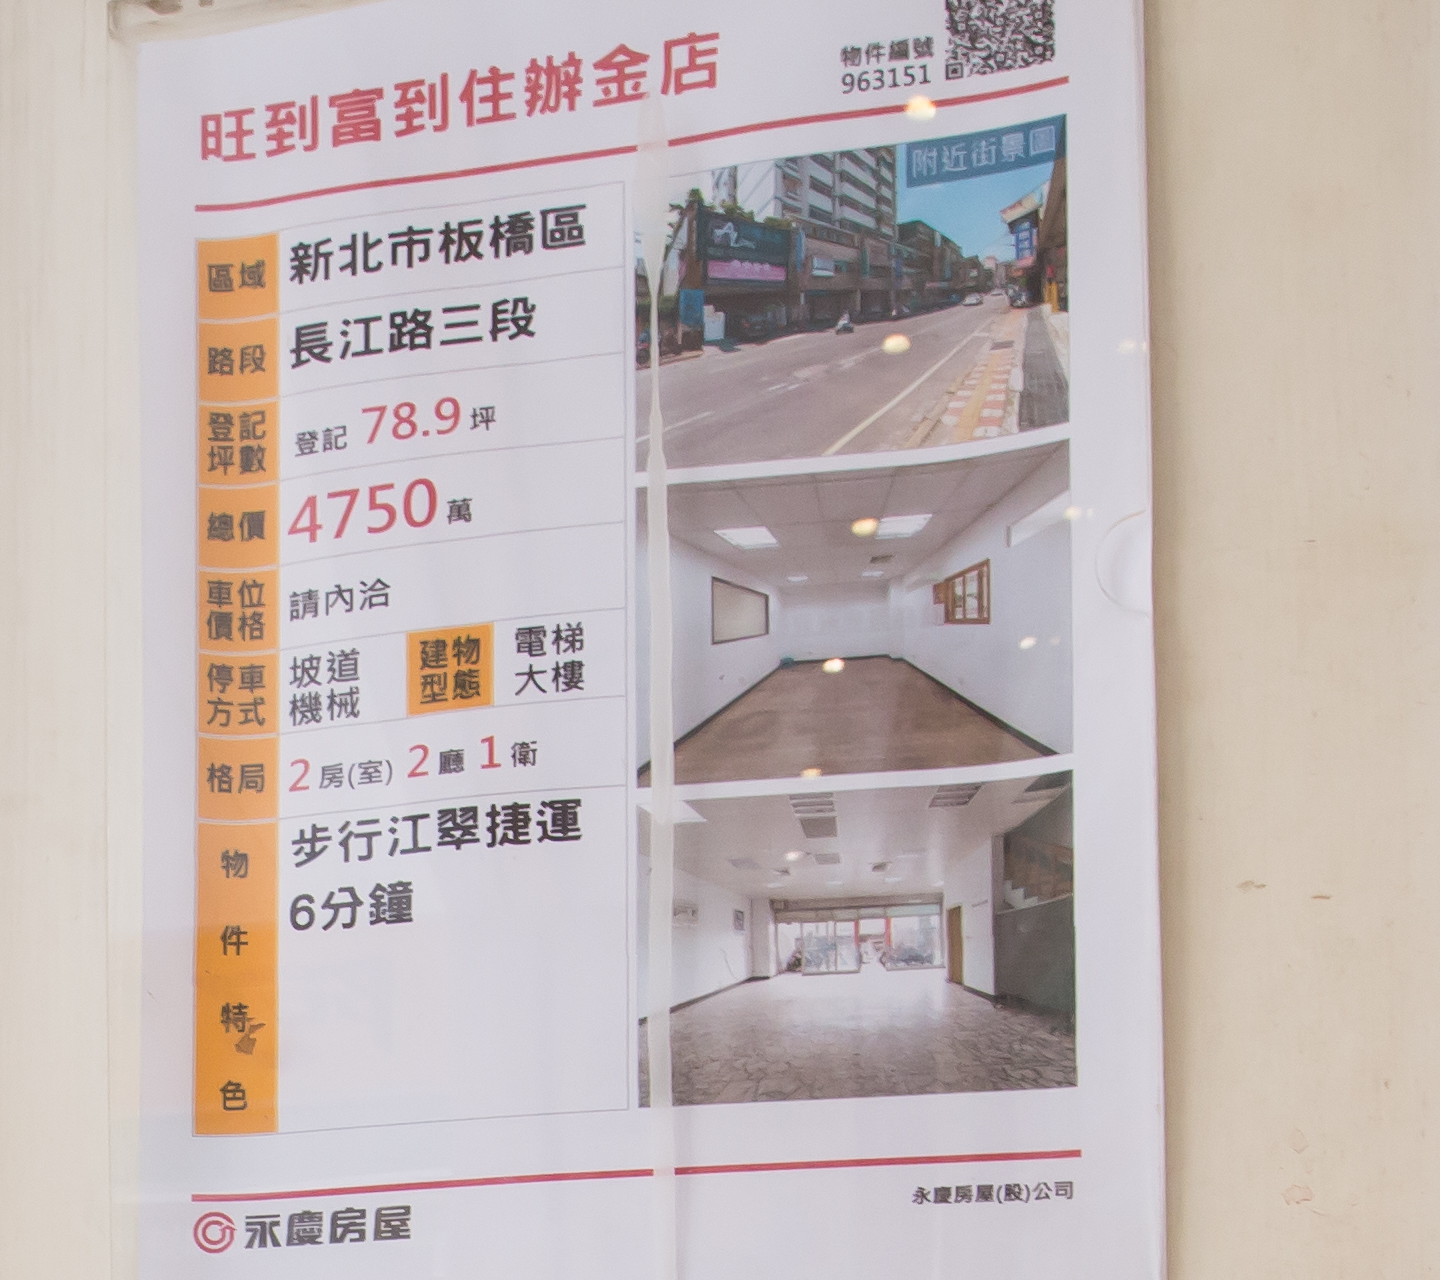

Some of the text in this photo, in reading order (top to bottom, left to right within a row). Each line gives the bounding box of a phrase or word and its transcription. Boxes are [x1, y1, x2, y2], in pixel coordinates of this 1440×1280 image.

[198, 31, 723, 164] 旺到富到住辦金店
[841, 64, 931, 94] 963151
[289, 204, 587, 285] 新北市板橋區
[206, 259, 266, 293] 區域
[289, 296, 537, 370] 長江路三段
[207, 343, 266, 376] 路段
[207, 410, 266, 444] 登記
[295, 396, 496, 457] 登記 78.9 坪
[207, 444, 266, 475] 坪數
[206, 510, 266, 542] 總價
[287, 477, 472, 543] 4750 萬
[206, 579, 265, 610] 車位
[289, 577, 391, 622] 請內洽
[205, 609, 265, 642] 價格
[514, 621, 584, 658] 電梯
[289, 647, 360, 690] 坡道
[419, 634, 481, 670] 建物
[206, 662, 266, 695] 停車
[420, 667, 481, 705] 型態
[514, 659, 585, 697] 大樓
[206, 696, 266, 728] 方式
[289, 686, 361, 727] 機械
[206, 762, 265, 794] 格局
[288, 735, 538, 793] 2 房(室) 2 廳 1 衛
[291, 798, 582, 868] 步行江翠捷運
[289, 880, 414, 932] 6分鐘
[244, 1205, 412, 1249] 永慶房屋
